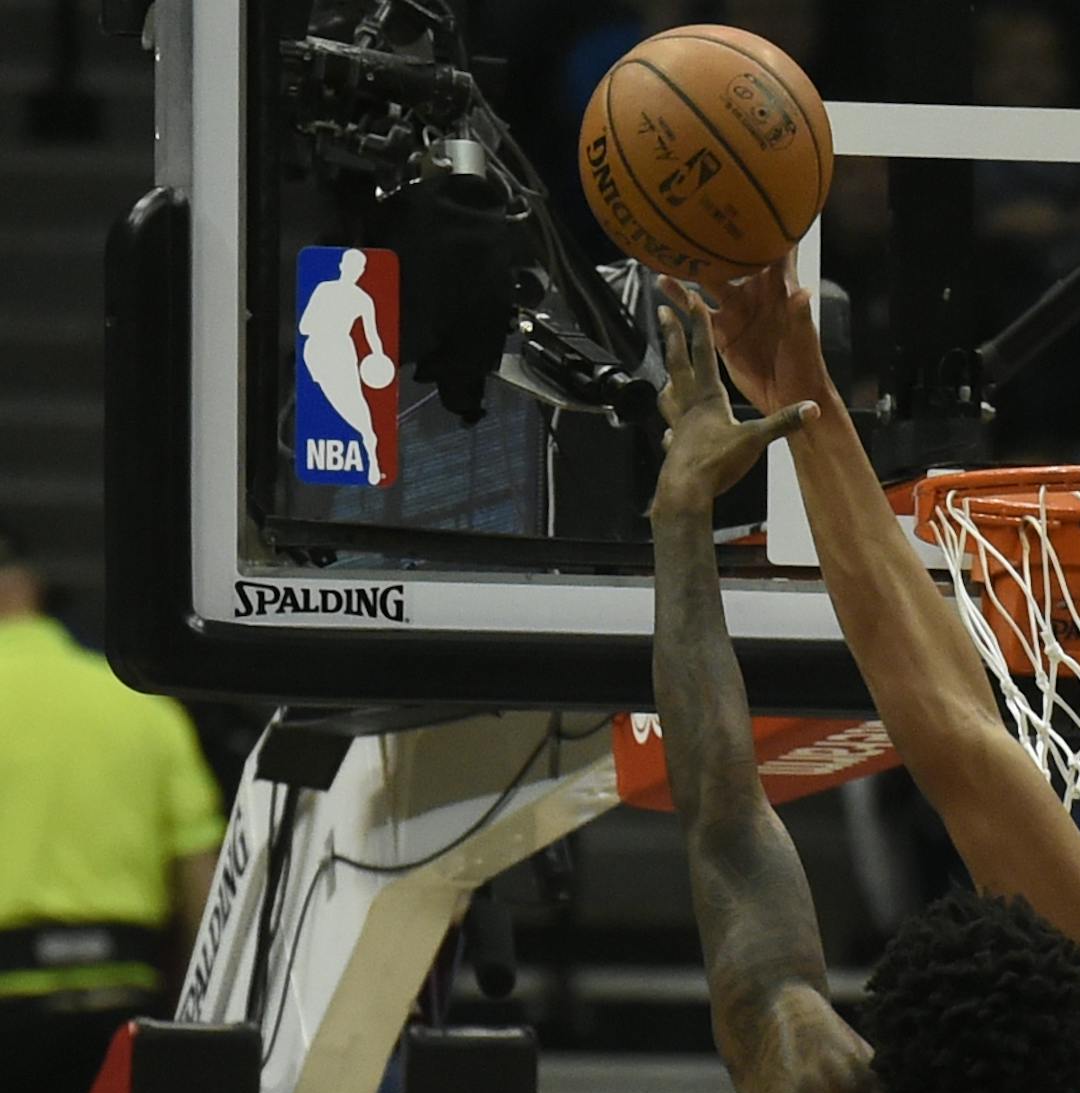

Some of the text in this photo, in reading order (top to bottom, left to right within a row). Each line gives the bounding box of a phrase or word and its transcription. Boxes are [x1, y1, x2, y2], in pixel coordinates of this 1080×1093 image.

[586, 134, 710, 271] SPALDING
[306, 438, 365, 473] NBA
[234, 580, 405, 623] SPALDING
[178, 804, 249, 1022] PALDING
